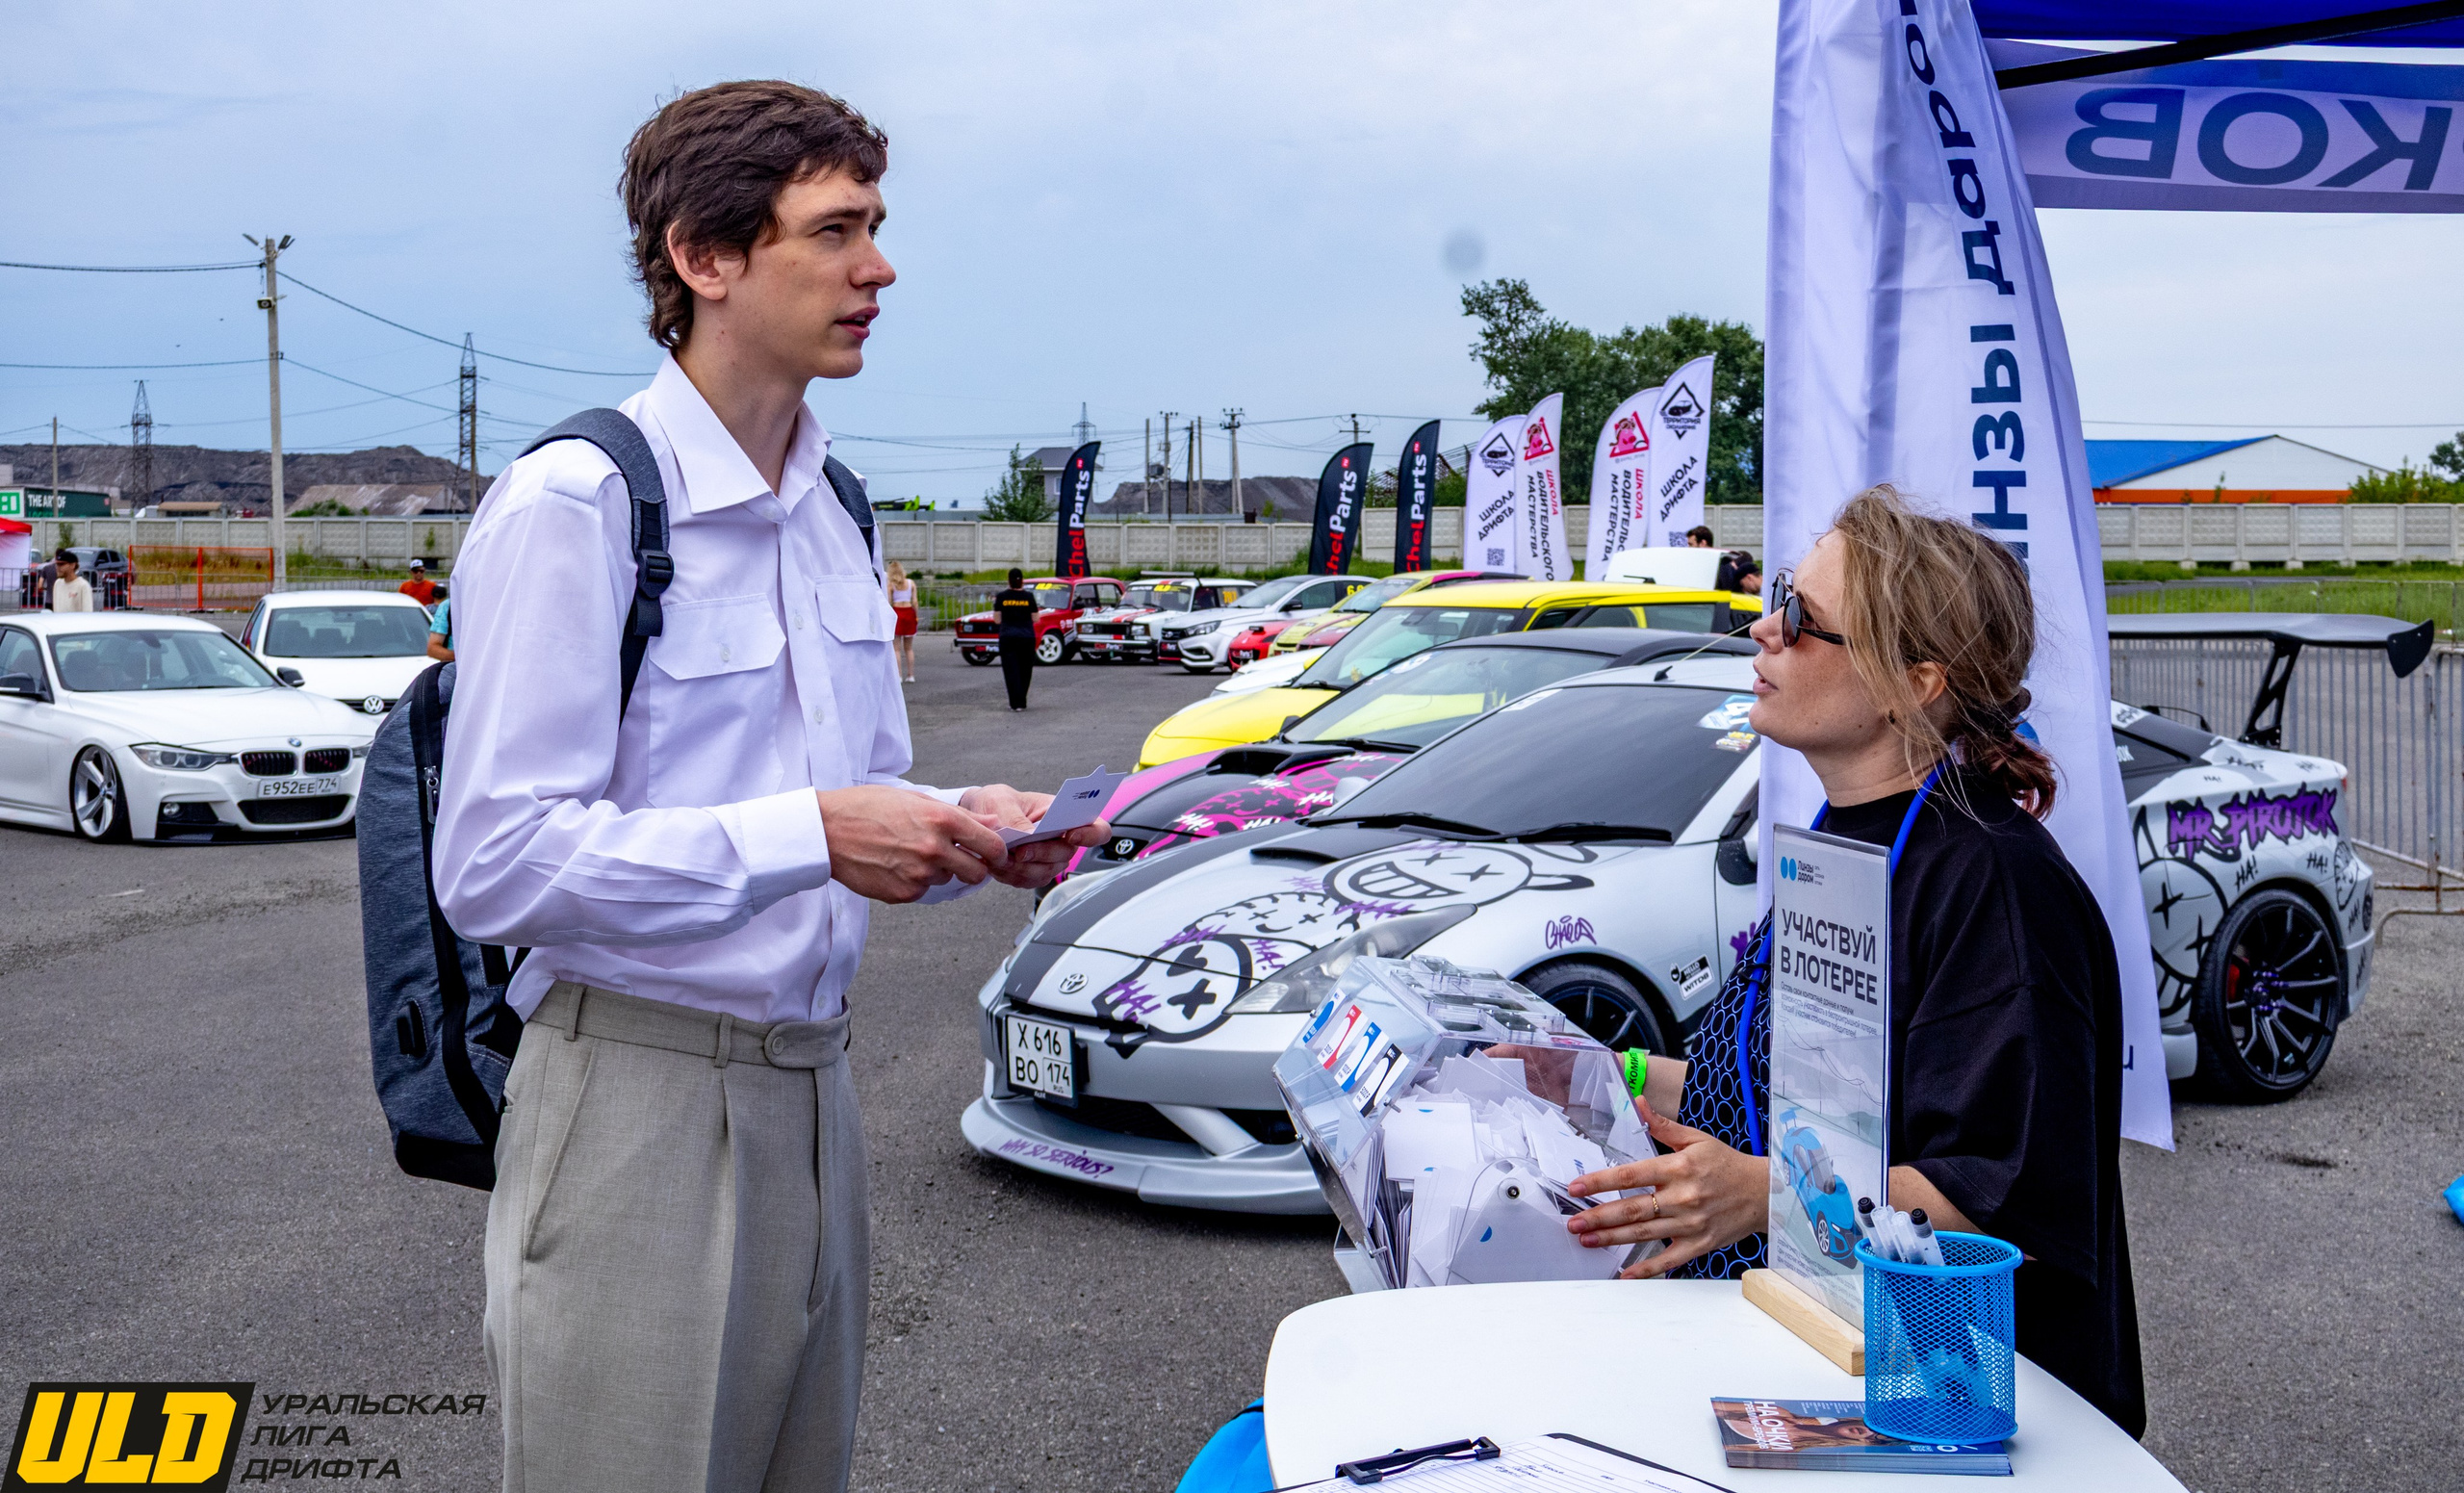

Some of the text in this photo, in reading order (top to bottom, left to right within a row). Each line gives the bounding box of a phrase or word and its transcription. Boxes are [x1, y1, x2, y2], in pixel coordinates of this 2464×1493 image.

[1970, 323, 2029, 553] нзы
[1546, 469, 1558, 516] ШКОЛА
[1635, 468, 1644, 520] ШКОЛА
[1660, 455, 1698, 498] ШКОЛА
[28, 494, 43, 507] THE
[1478, 490, 1514, 522] ШКОЛА
[1527, 475, 1539, 558] МАСТЕРСТВА
[1602, 473, 1618, 562] МАСТЕРСТВА
[1617, 470, 1631, 553] ВОДИТЕЛЬС
[1659, 477, 1699, 523] ДРИФТА
[1477, 507, 1514, 541] ДРИФТА
[1536, 471, 1554, 581] ВОДИТЕЛЬСКОГО
[2235, 855, 2259, 891] HA!
[2306, 852, 2329, 874] HA!
[1782, 909, 1876, 965] УЧАСТВУЙ
[1781, 945, 1878, 1006] В ЛОТЕРЕЕ
[1034, 1026, 1062, 1056] 616
[1047, 1063, 1070, 1087] 174
[1040, 1146, 1114, 1179] SERIOUS?
[1754, 1401, 1794, 1451] НА ОЧКИ
